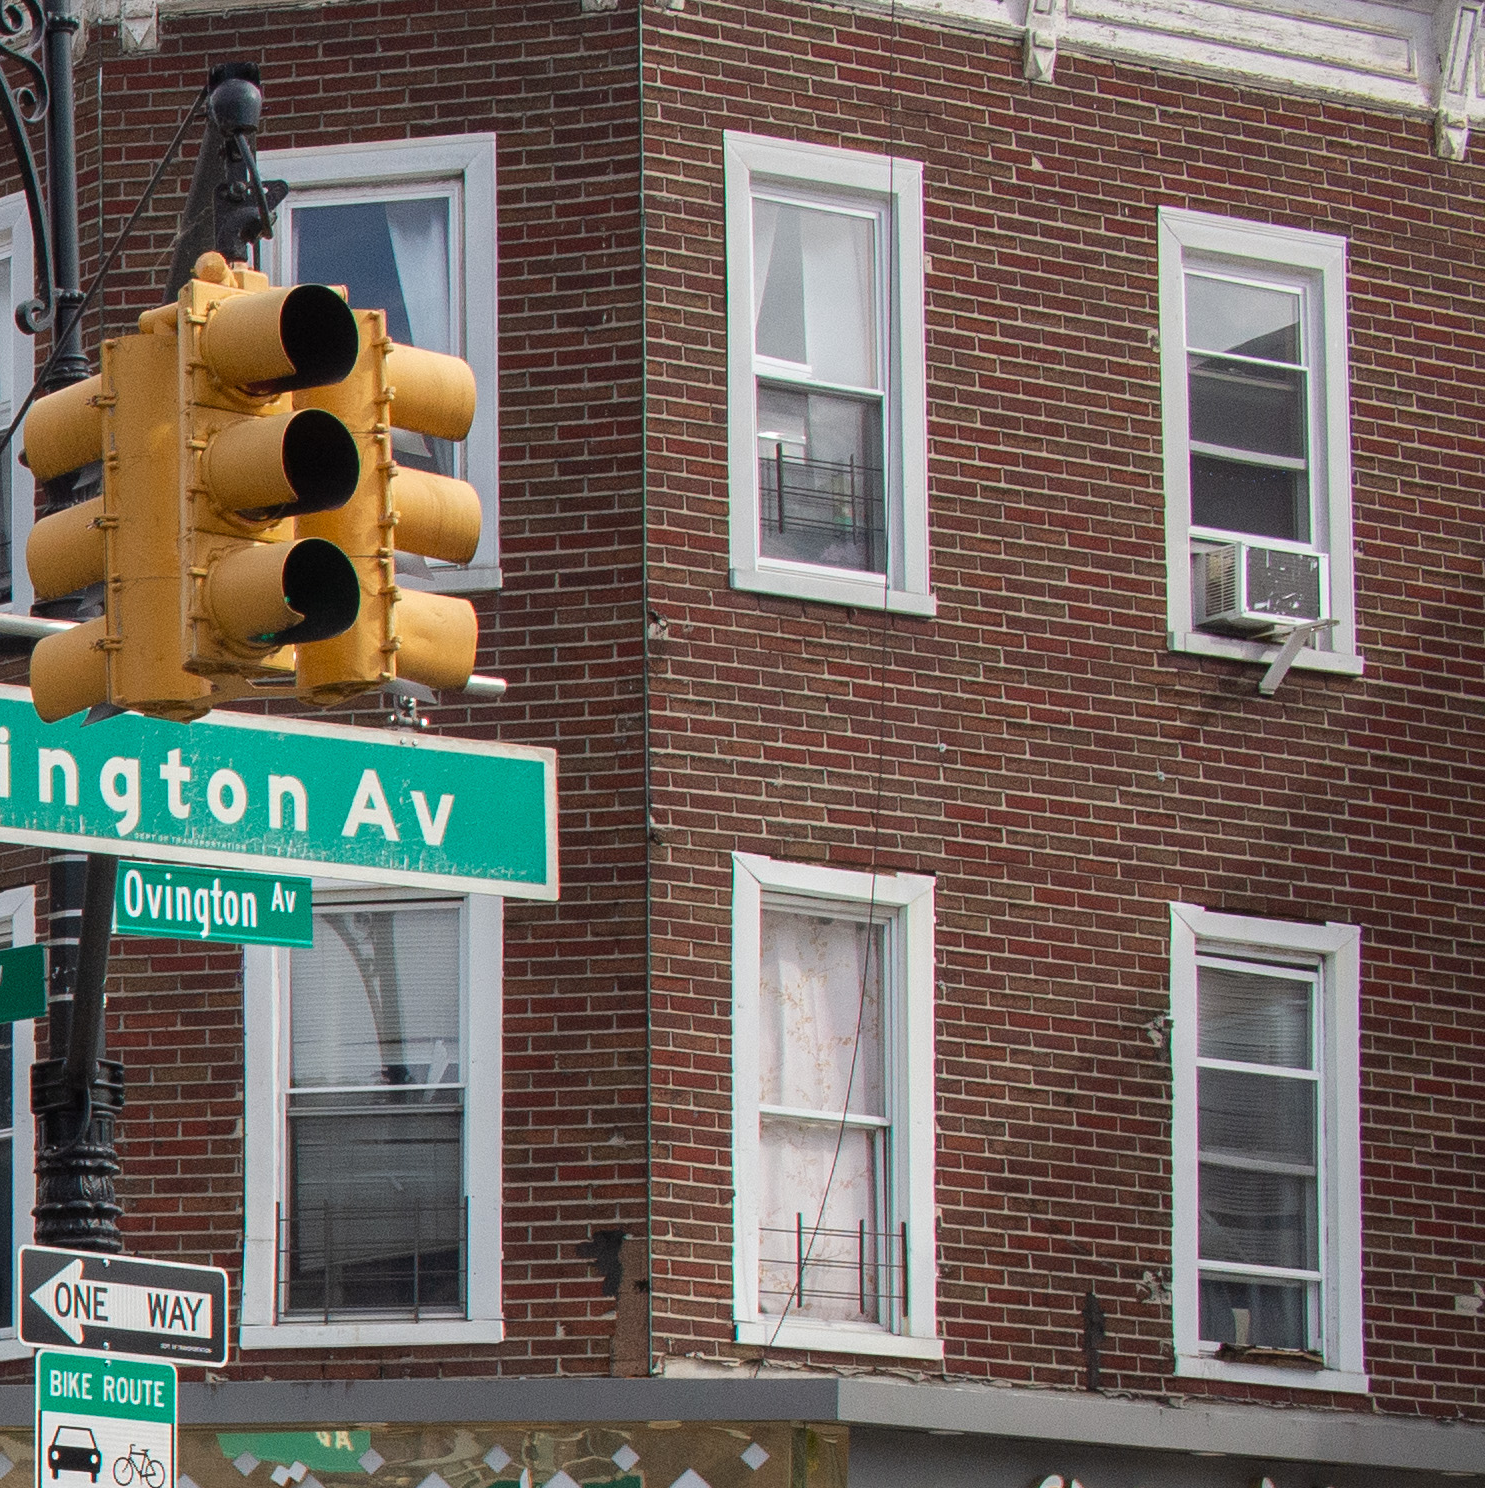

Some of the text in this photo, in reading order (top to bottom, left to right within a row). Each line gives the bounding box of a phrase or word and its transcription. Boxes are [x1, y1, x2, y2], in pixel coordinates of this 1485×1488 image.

[342, 769, 455, 846] Av
[124, 870, 296, 938] Ovington Av
[54, 1282, 204, 1333] ONE WAY
[49, 1370, 166, 1408] BIKE ROUTE
